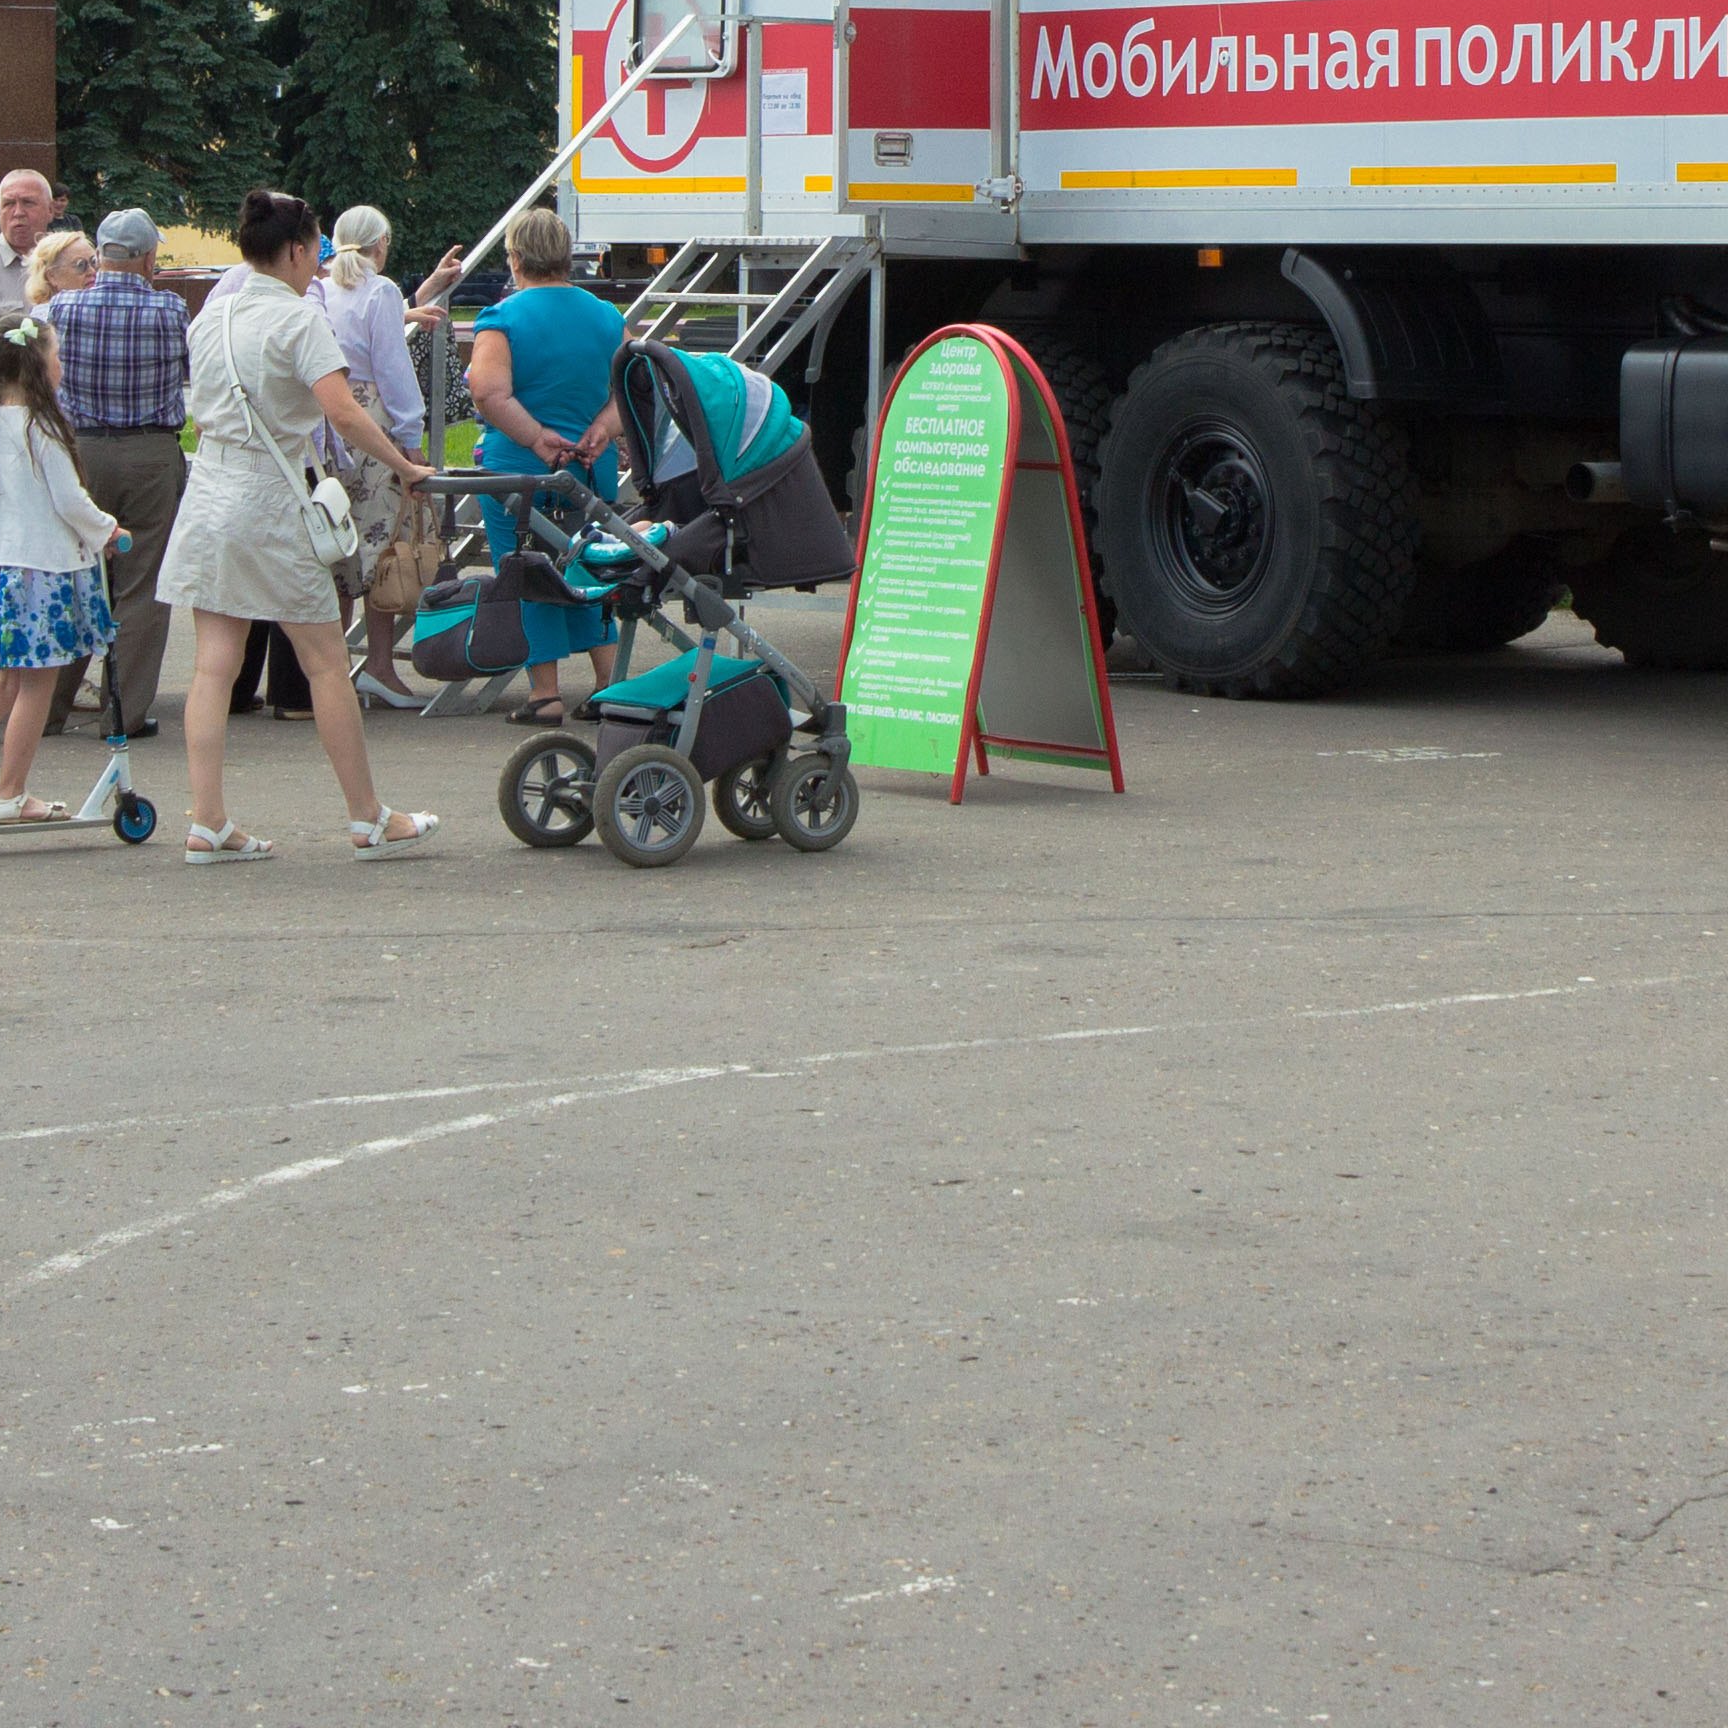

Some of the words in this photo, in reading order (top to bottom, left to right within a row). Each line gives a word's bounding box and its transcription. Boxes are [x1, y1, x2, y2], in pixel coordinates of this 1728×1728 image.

[1030, 17, 1400, 100] Мобильная
[941, 342, 978, 361] Центр
[929, 362, 982, 378] здоровья
[905, 416, 986, 437] БЕСПЛАТНОЕ
[894, 439, 990, 459] компьютерное
[893, 456, 986, 478] обследование
